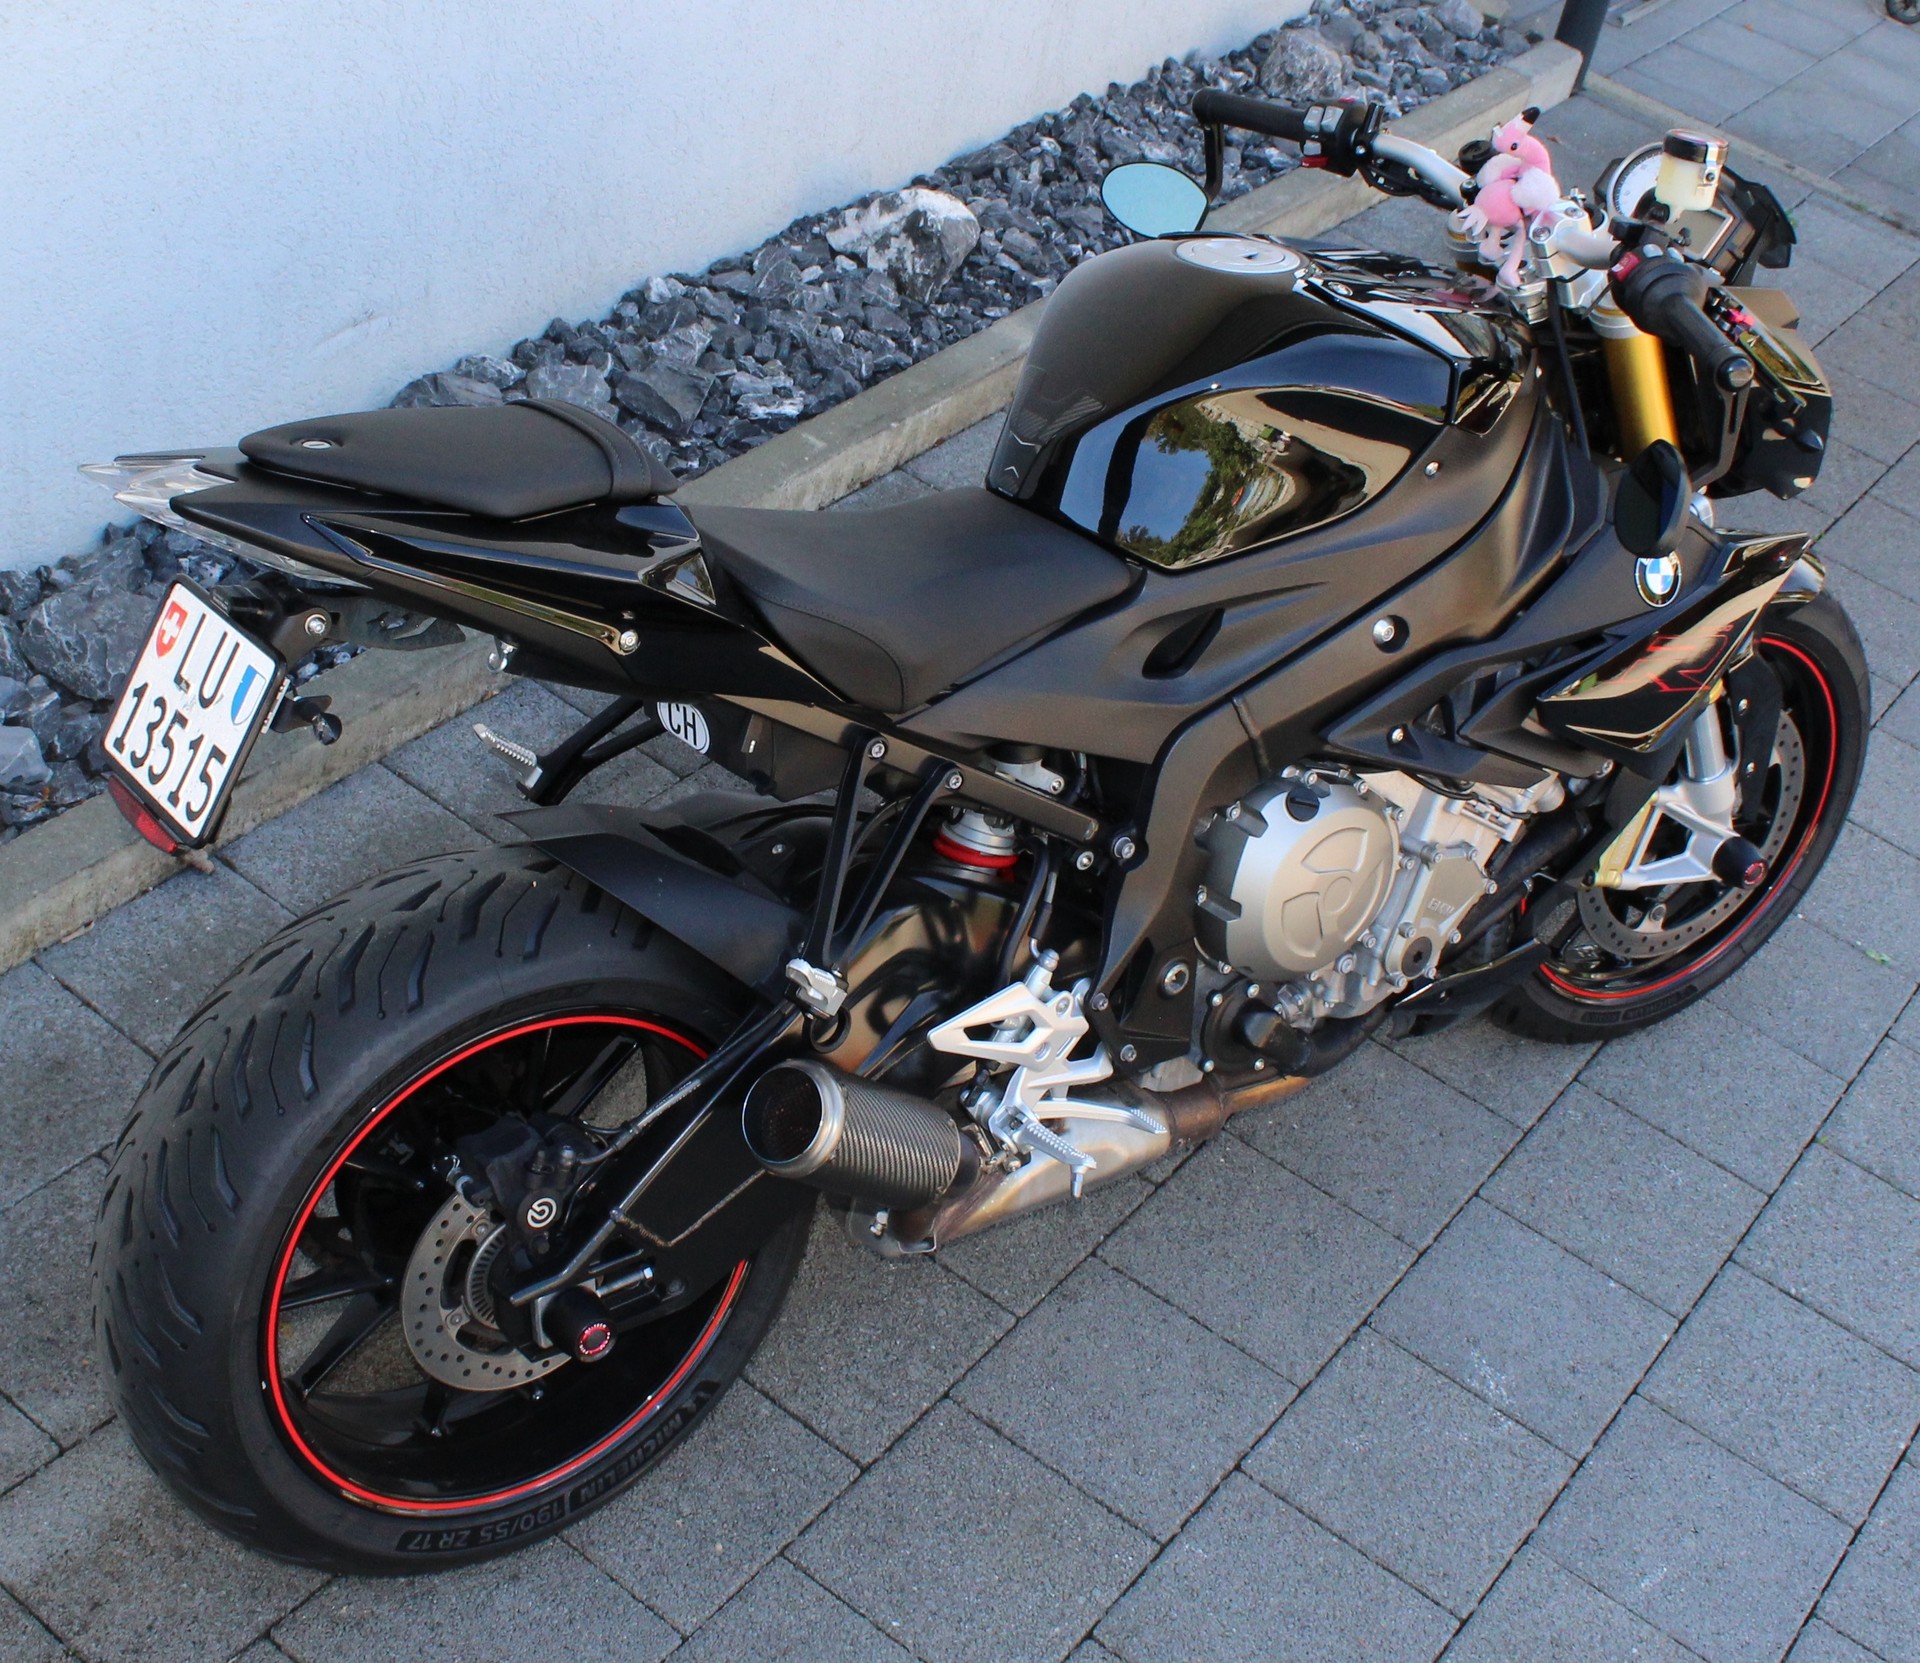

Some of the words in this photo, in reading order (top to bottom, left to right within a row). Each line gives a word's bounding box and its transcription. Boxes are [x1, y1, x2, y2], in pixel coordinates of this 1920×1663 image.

[174, 613, 240, 709] LU
[668, 703, 697, 746] CH
[113, 682, 227, 821] 13515
[579, 1413, 684, 1498] MICHELIN
[407, 1531, 432, 1549] 17
[439, 1528, 472, 1549] ZR
[480, 1499, 562, 1543] 190/55
